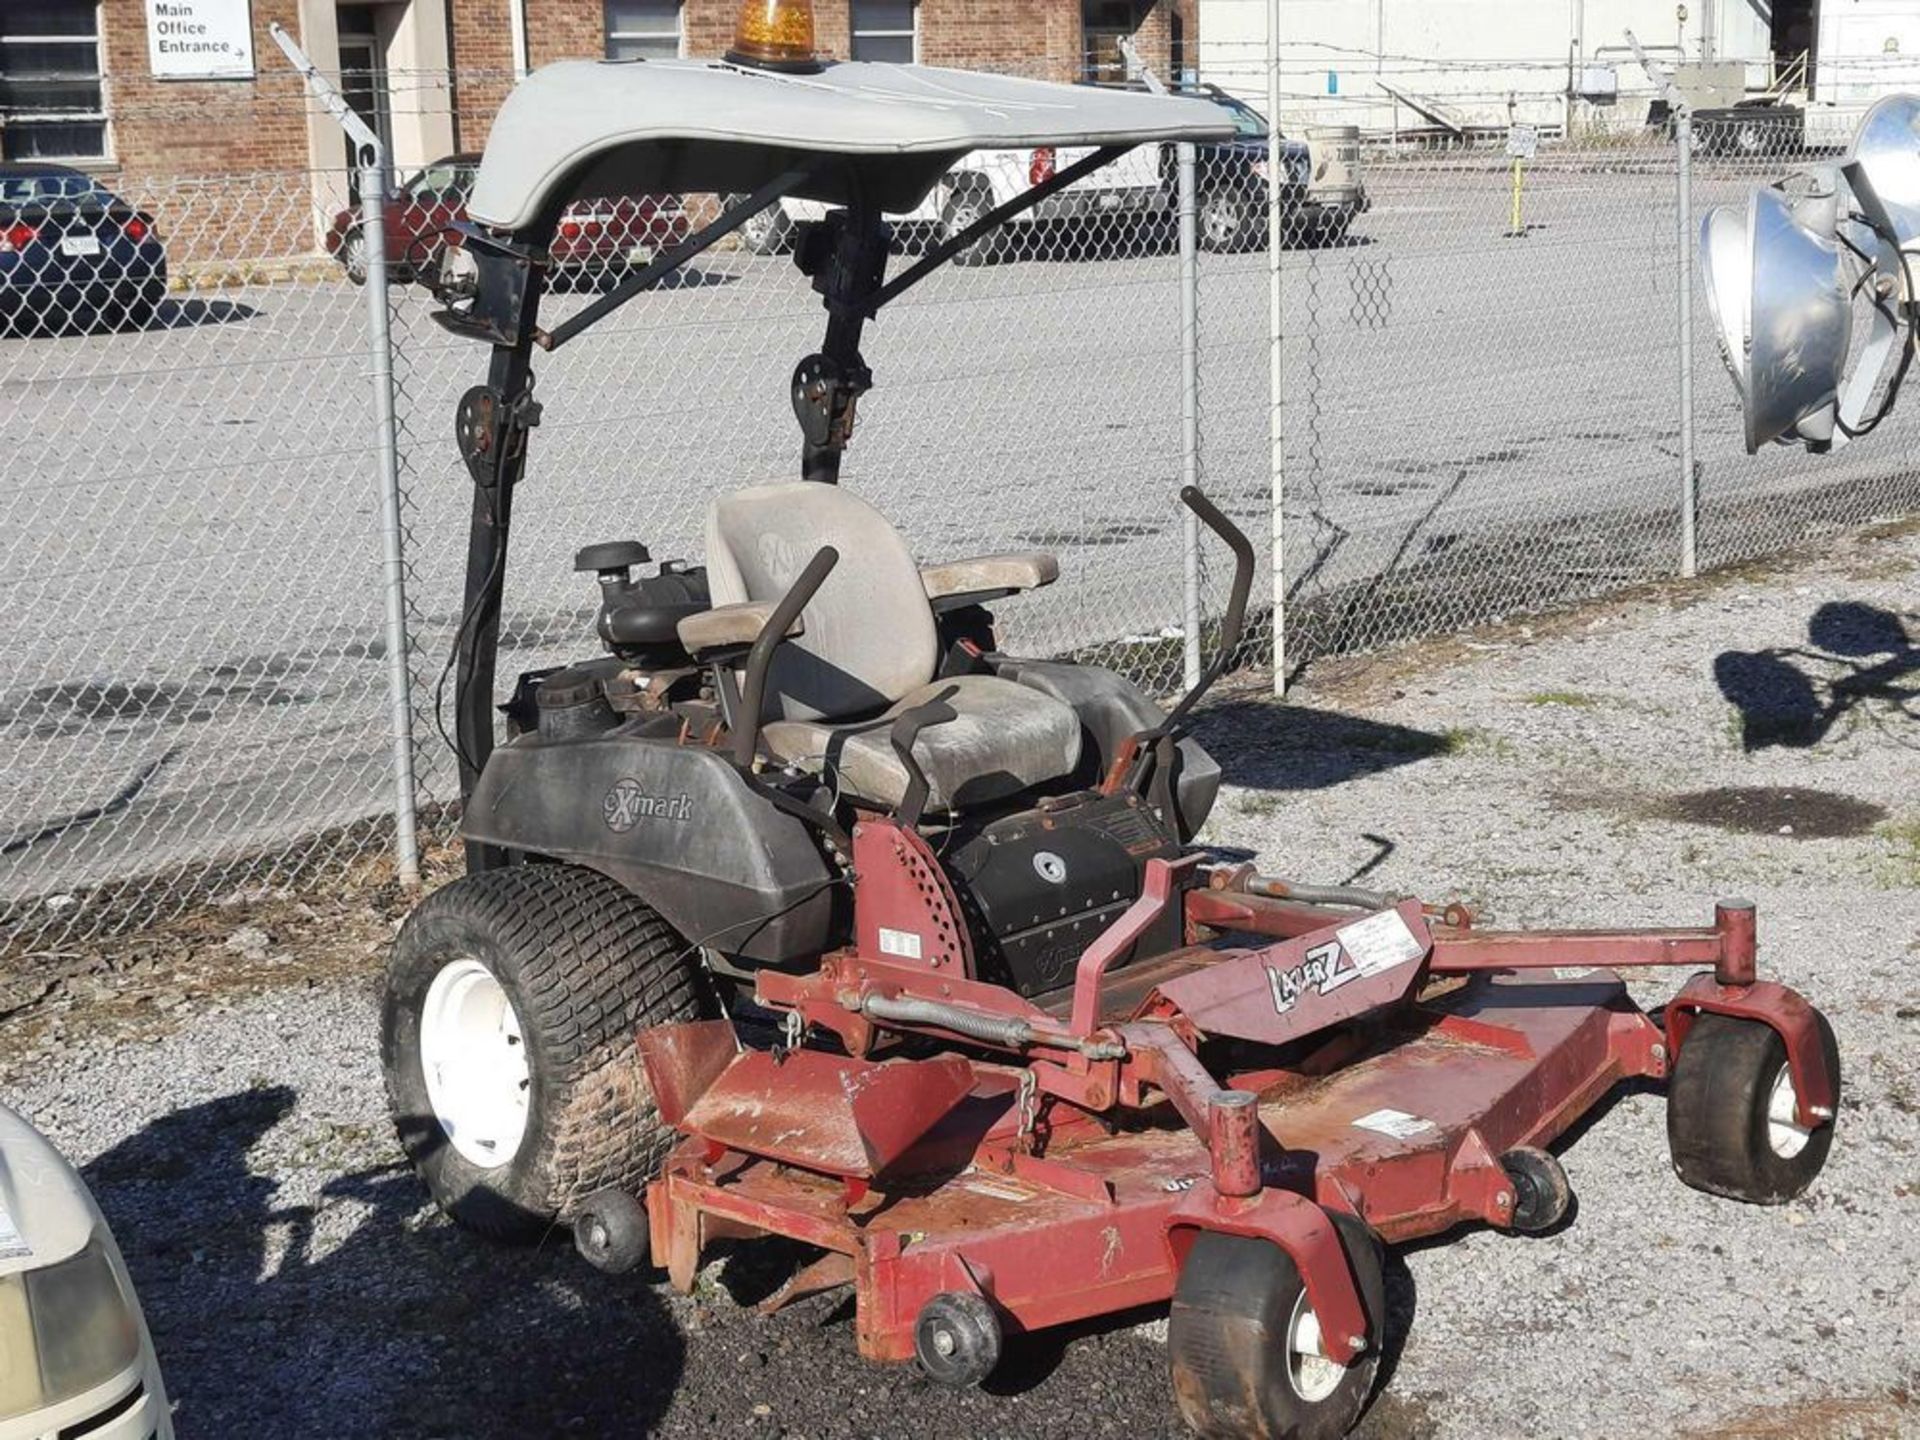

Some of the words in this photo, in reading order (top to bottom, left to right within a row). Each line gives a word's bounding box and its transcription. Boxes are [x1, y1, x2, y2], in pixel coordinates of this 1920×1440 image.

[155, 3, 193, 16] Main
[157, 20, 206, 35] Office
[158, 40, 229, 53] Entrance
[1306, 940, 1362, 997] Z
